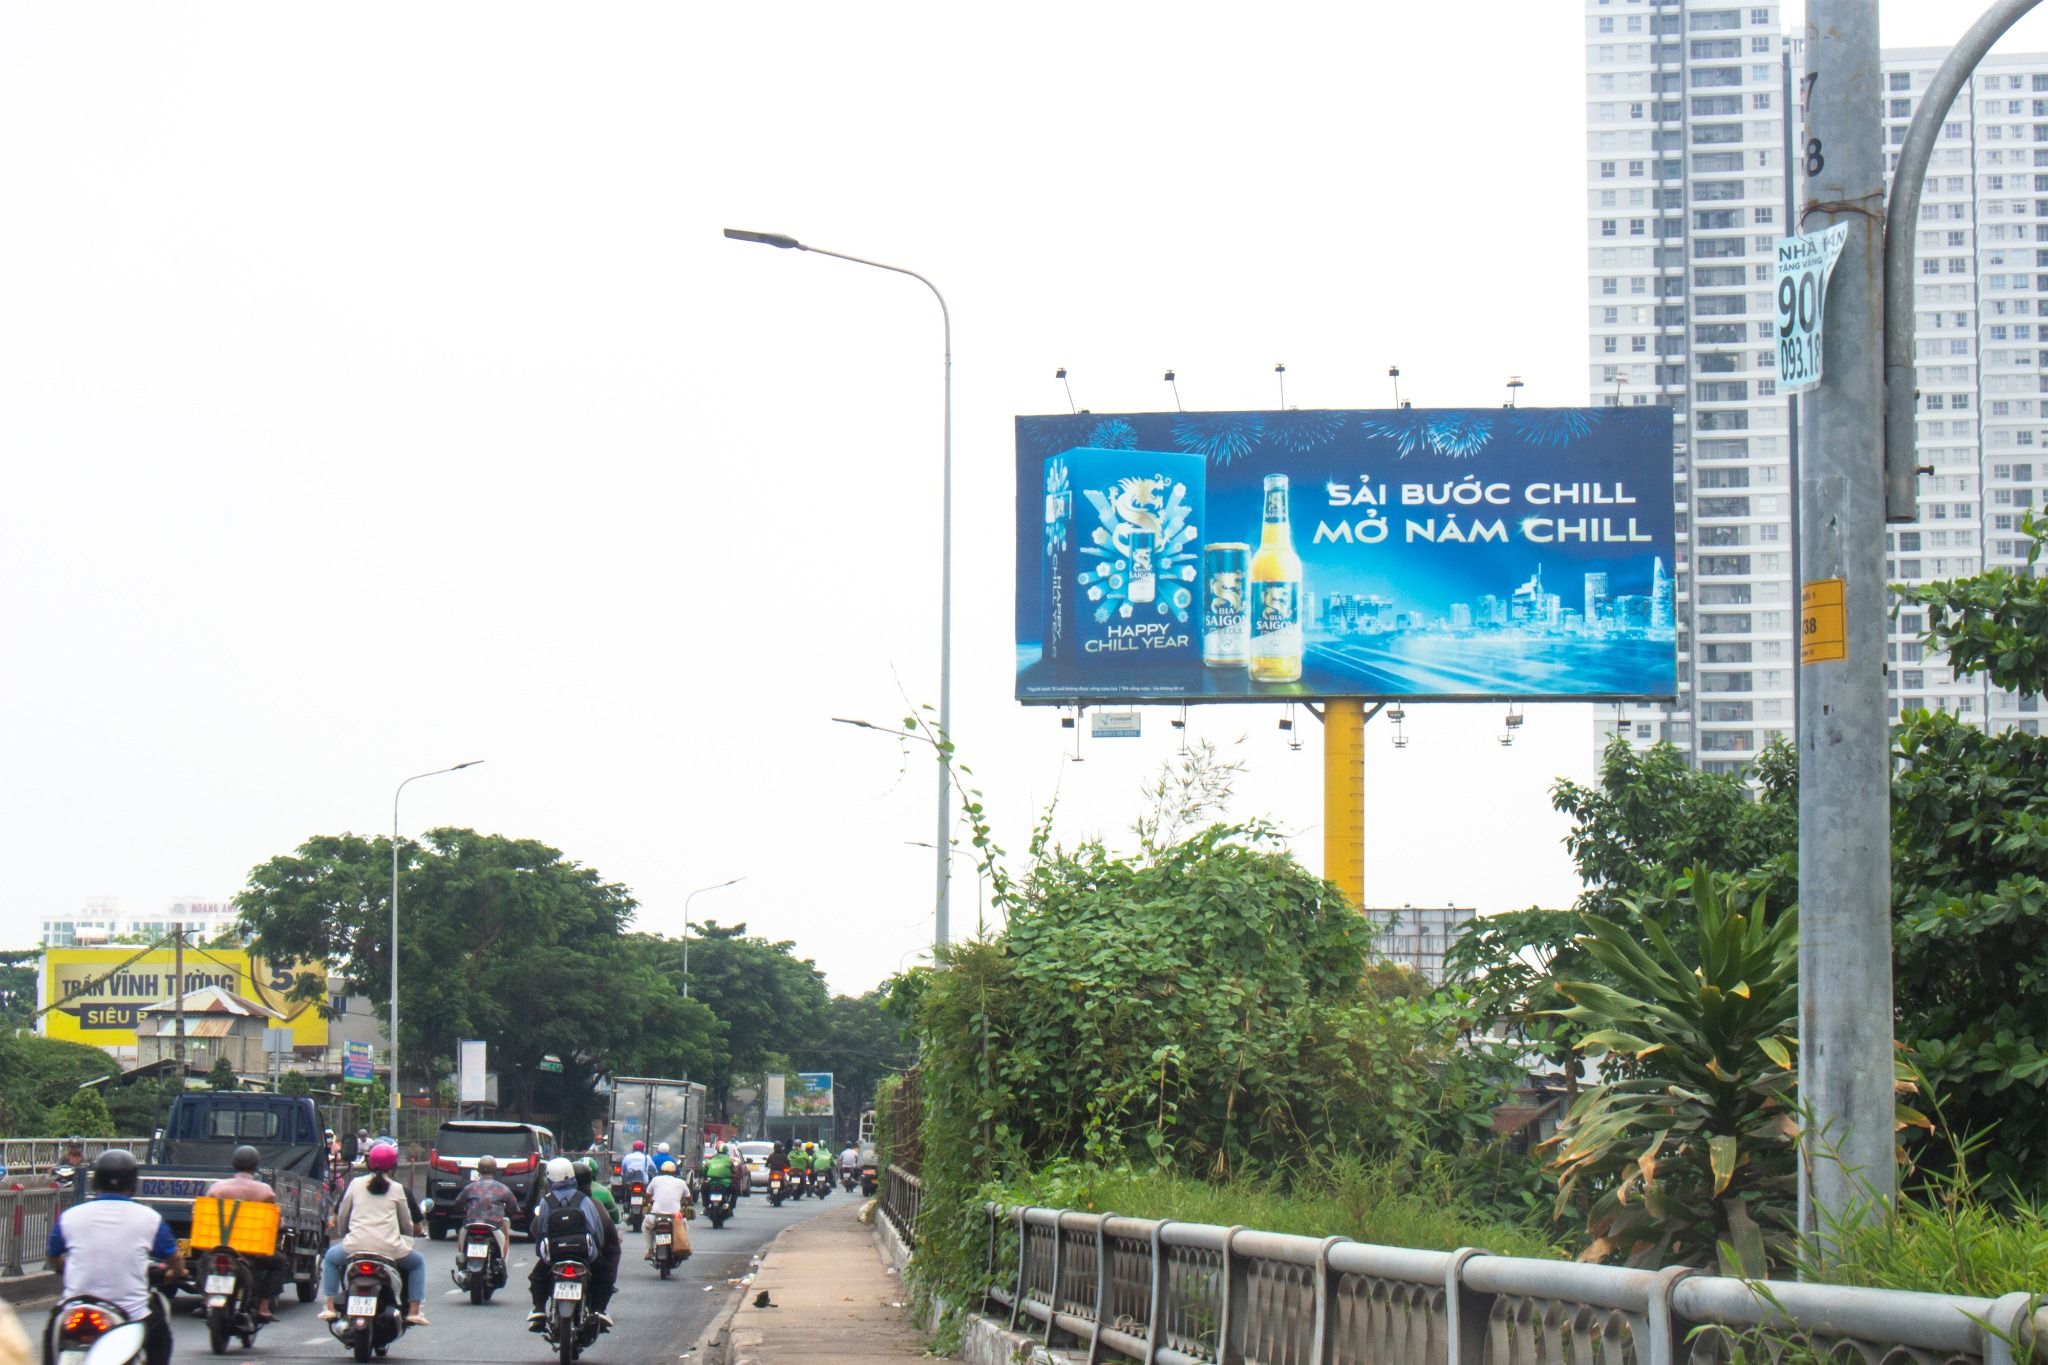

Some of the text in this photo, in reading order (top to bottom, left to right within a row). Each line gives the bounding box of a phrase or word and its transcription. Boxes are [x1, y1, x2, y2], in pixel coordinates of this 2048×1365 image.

[1806, 137, 1825, 178] 8
[1779, 236, 1818, 262] NHÀ
[1328, 473, 1637, 506] SẢI BƯỚC CHILL
[1312, 508, 1653, 544] MỞ NĂM CHILL
[1218, 607, 1236, 615] BIA
[1084, 634, 1189, 653] CHILL YEAR
[1107, 622, 1171, 639] HAPPY
[108, 968, 159, 997] VĨNH
[87, 1005, 130, 1025] SIÊU
